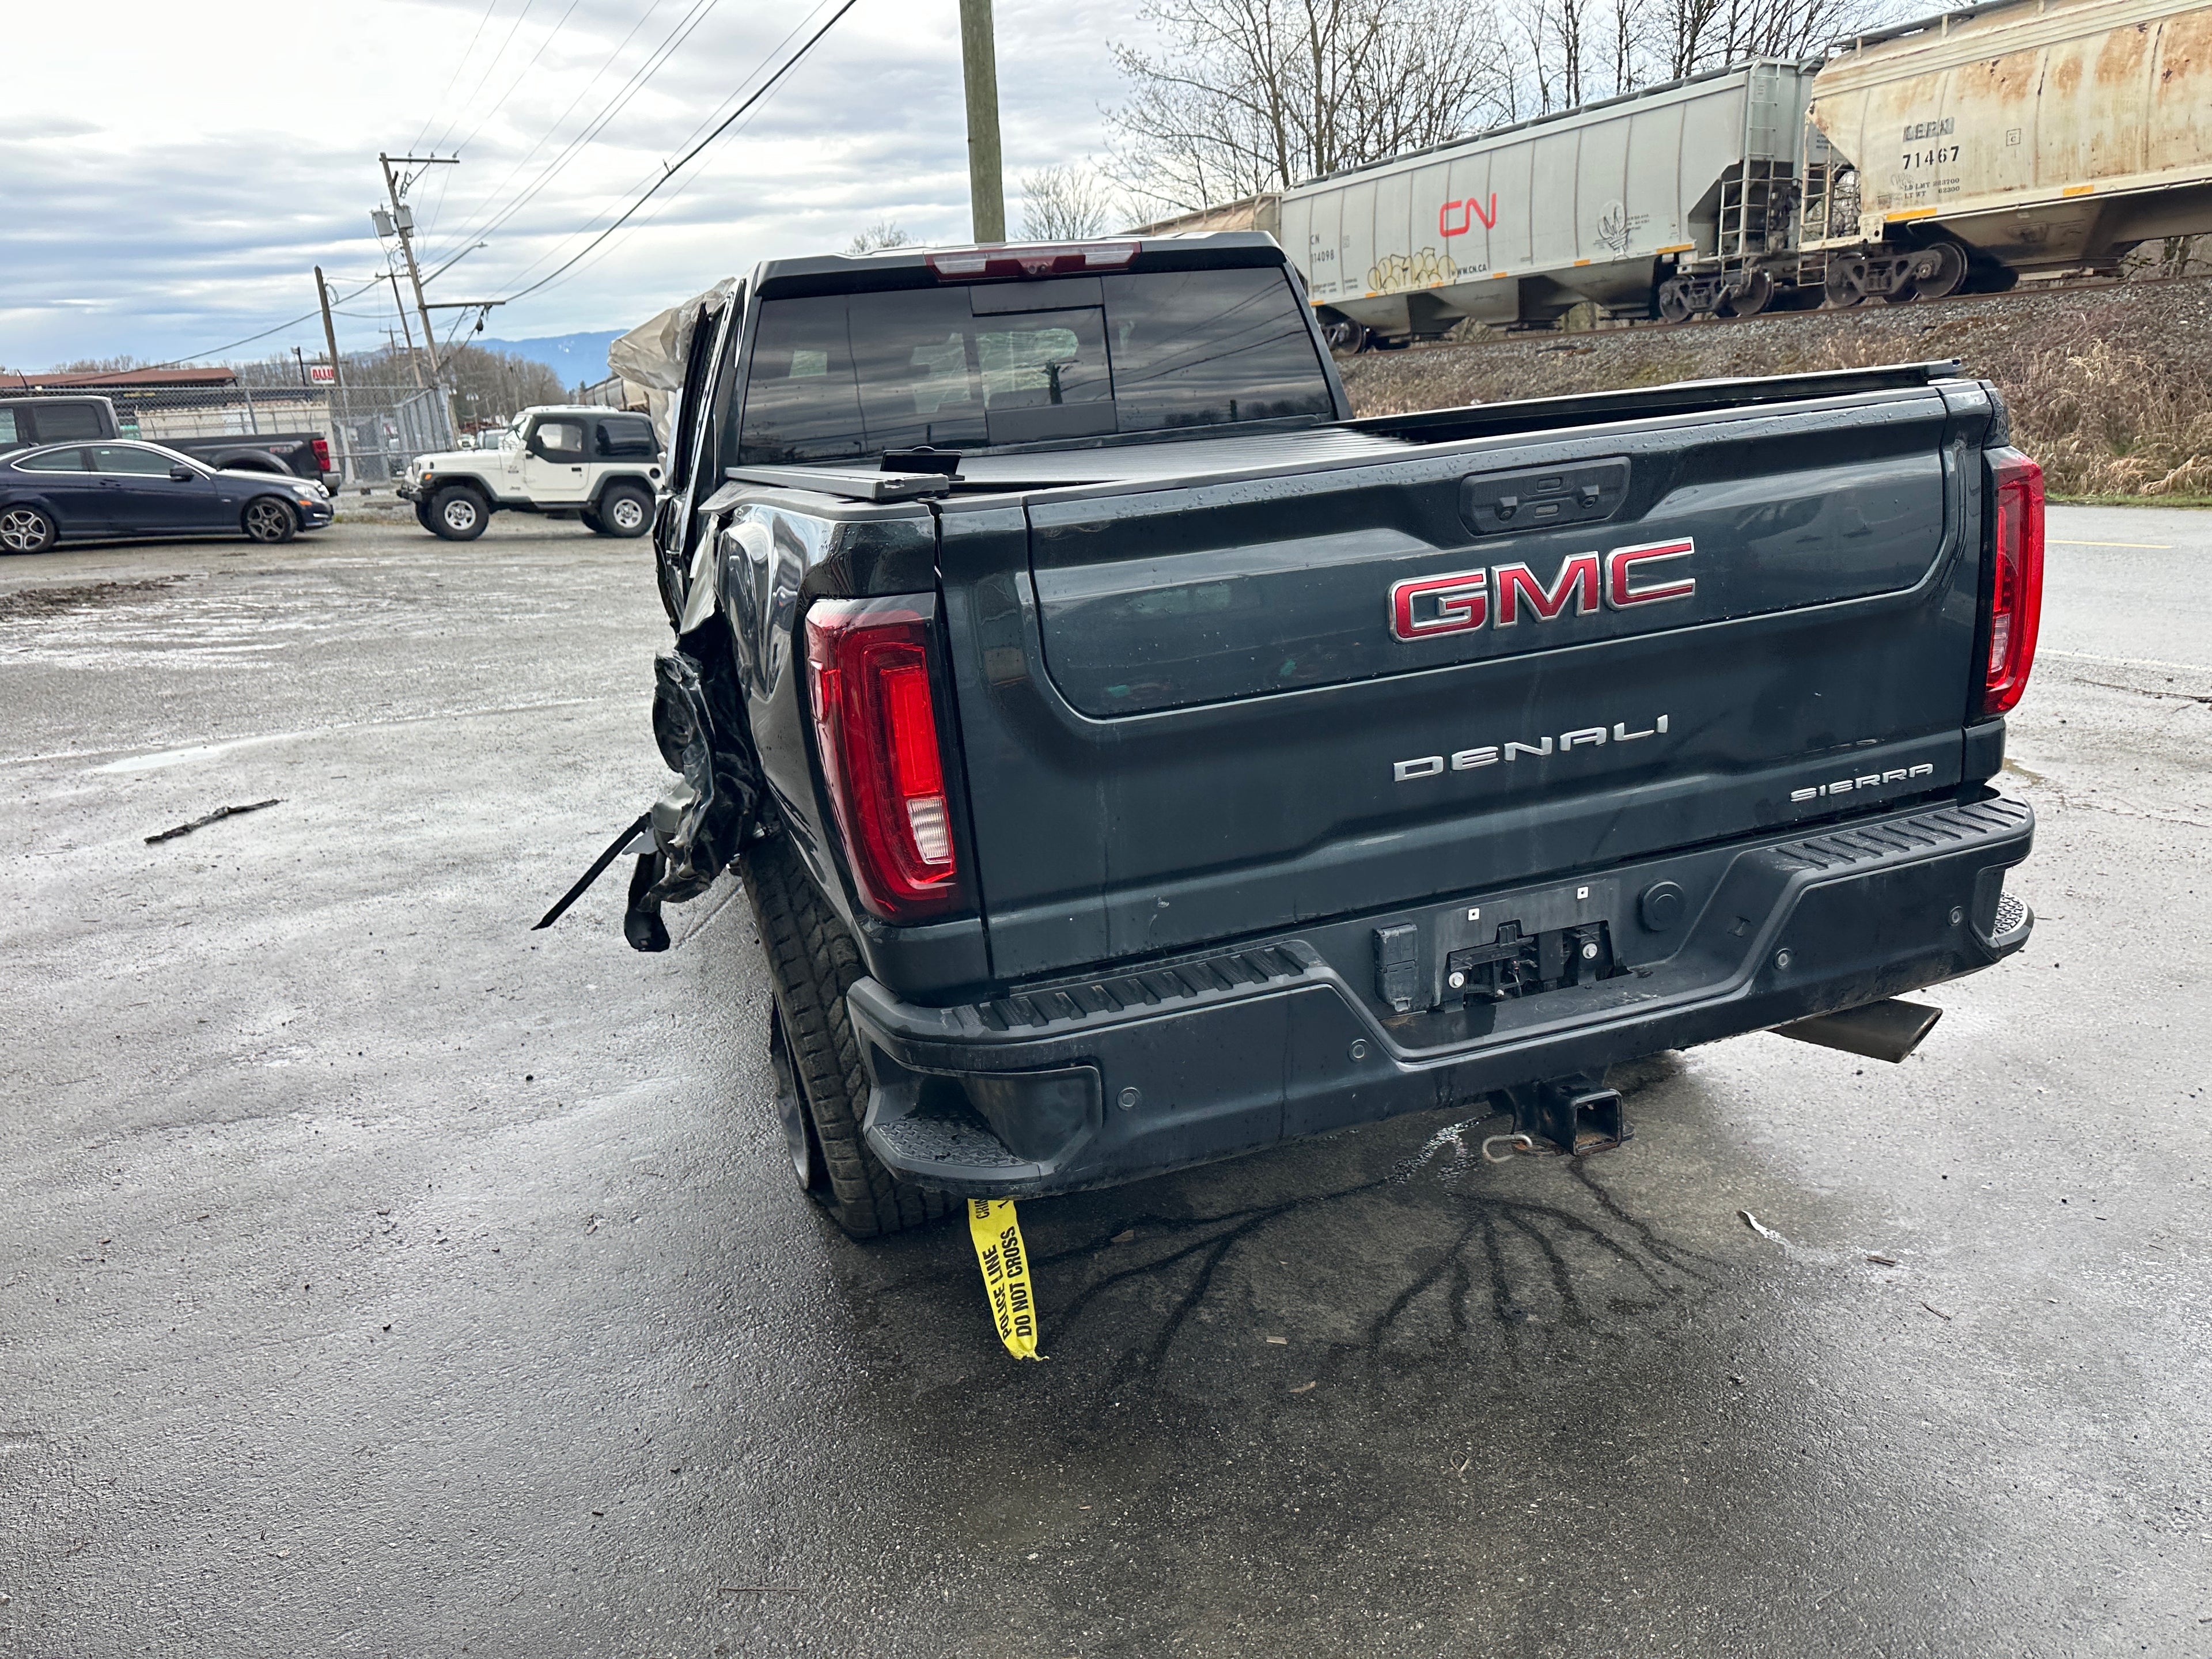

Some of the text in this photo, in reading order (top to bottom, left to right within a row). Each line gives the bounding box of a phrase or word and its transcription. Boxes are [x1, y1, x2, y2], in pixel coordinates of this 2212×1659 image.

[1903, 145, 1959, 169] 71467
[1938, 185, 1960, 194] 62300
[1440, 192, 1497, 237] CN
[1310, 234, 1320, 245] CN
[1389, 536, 1696, 643] GMC
[1393, 714, 1668, 782] DENALI
[1790, 763, 1933, 802] SIERRA
[982, 1244, 1012, 1341] POLICE LINE
[1000, 1225, 1032, 1337] DO NOT CROSS
